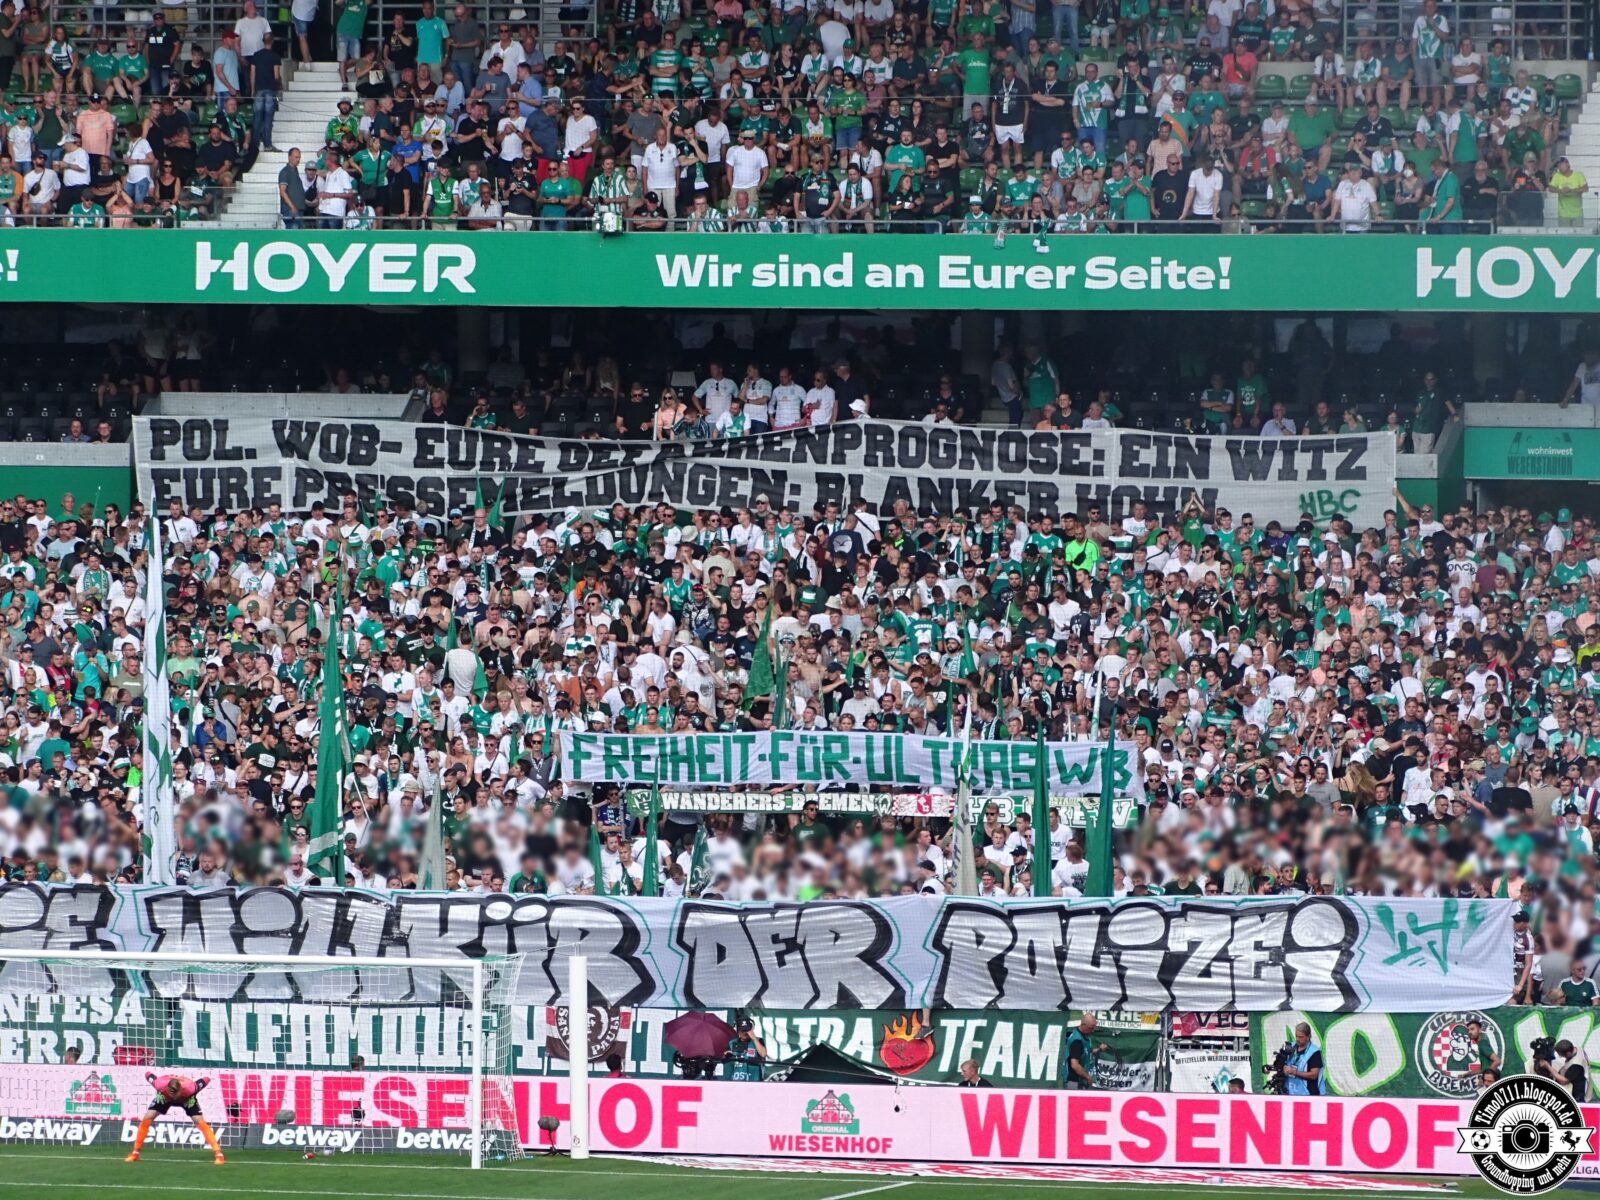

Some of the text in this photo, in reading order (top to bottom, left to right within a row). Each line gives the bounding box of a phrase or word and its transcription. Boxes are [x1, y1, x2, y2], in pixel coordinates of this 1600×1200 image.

[195, 241, 477, 293] HOYER
[654, 251, 1233, 290] Wir sind an Eurer Seite!
[1416, 246, 1600, 299] HOY
[150, 418, 257, 461] POL.
[271, 419, 403, 467] WOB-
[413, 426, 546, 472] EURE
[1118, 433, 1211, 480] EIN
[1225, 436, 1368, 482] WITZ
[1527, 446, 1574, 456] wohninvest
[151, 466, 282, 511] EURE
[815, 470, 1061, 522] BLANKER
[1298, 488, 1362, 518] HBC
[675, 901, 906, 1009] DER
[178, 999, 499, 1070] INFAMOUS
[938, 1019, 1062, 1081] TEAM
[1428, 1070, 1483, 1093] BREME
[0, 1116, 102, 1145] betway
[262, 1124, 362, 1152] betway
[769, 1134, 893, 1154] WIESENHOF
[811, 1125, 849, 1133] ORIGINAL
[959, 1092, 1462, 1170] WIESENHOF
